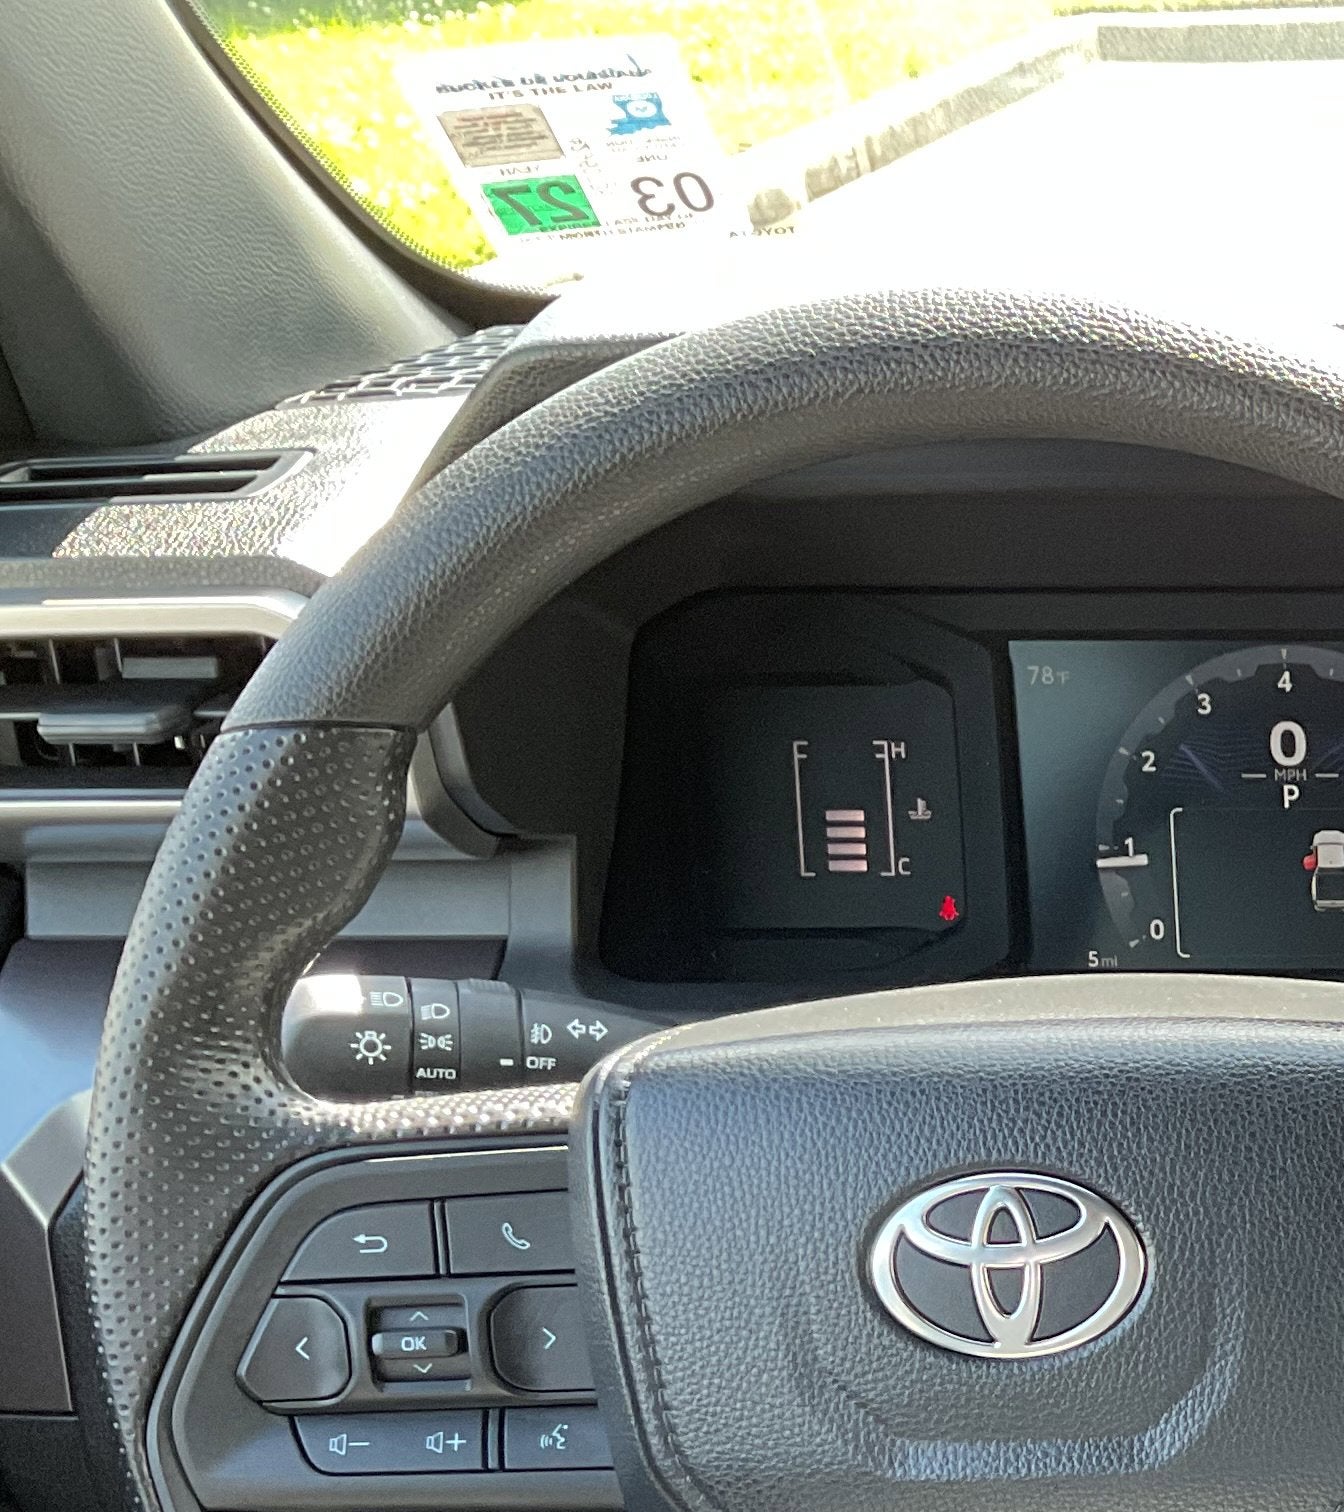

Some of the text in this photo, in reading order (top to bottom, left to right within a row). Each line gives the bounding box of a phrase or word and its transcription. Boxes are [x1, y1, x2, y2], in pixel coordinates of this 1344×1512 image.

[488, 81, 613, 100] IT'S THE LAW
[1277, 671, 1293, 693] 4
[1197, 693, 1212, 715] 3
[890, 742, 906, 759] H
[1269, 720, 1308, 767] 0
[1141, 751, 1157, 772] 2
[1274, 768, 1308, 782] MPH
[1282, 785, 1300, 809] P
[1124, 836, 1134, 857] 1
[898, 857, 912, 876] C
[1150, 918, 1165, 940] 0
[525, 1056, 557, 1070] OFF
[415, 1067, 457, 1080] AUTO
[400, 1335, 427, 1352] OK
